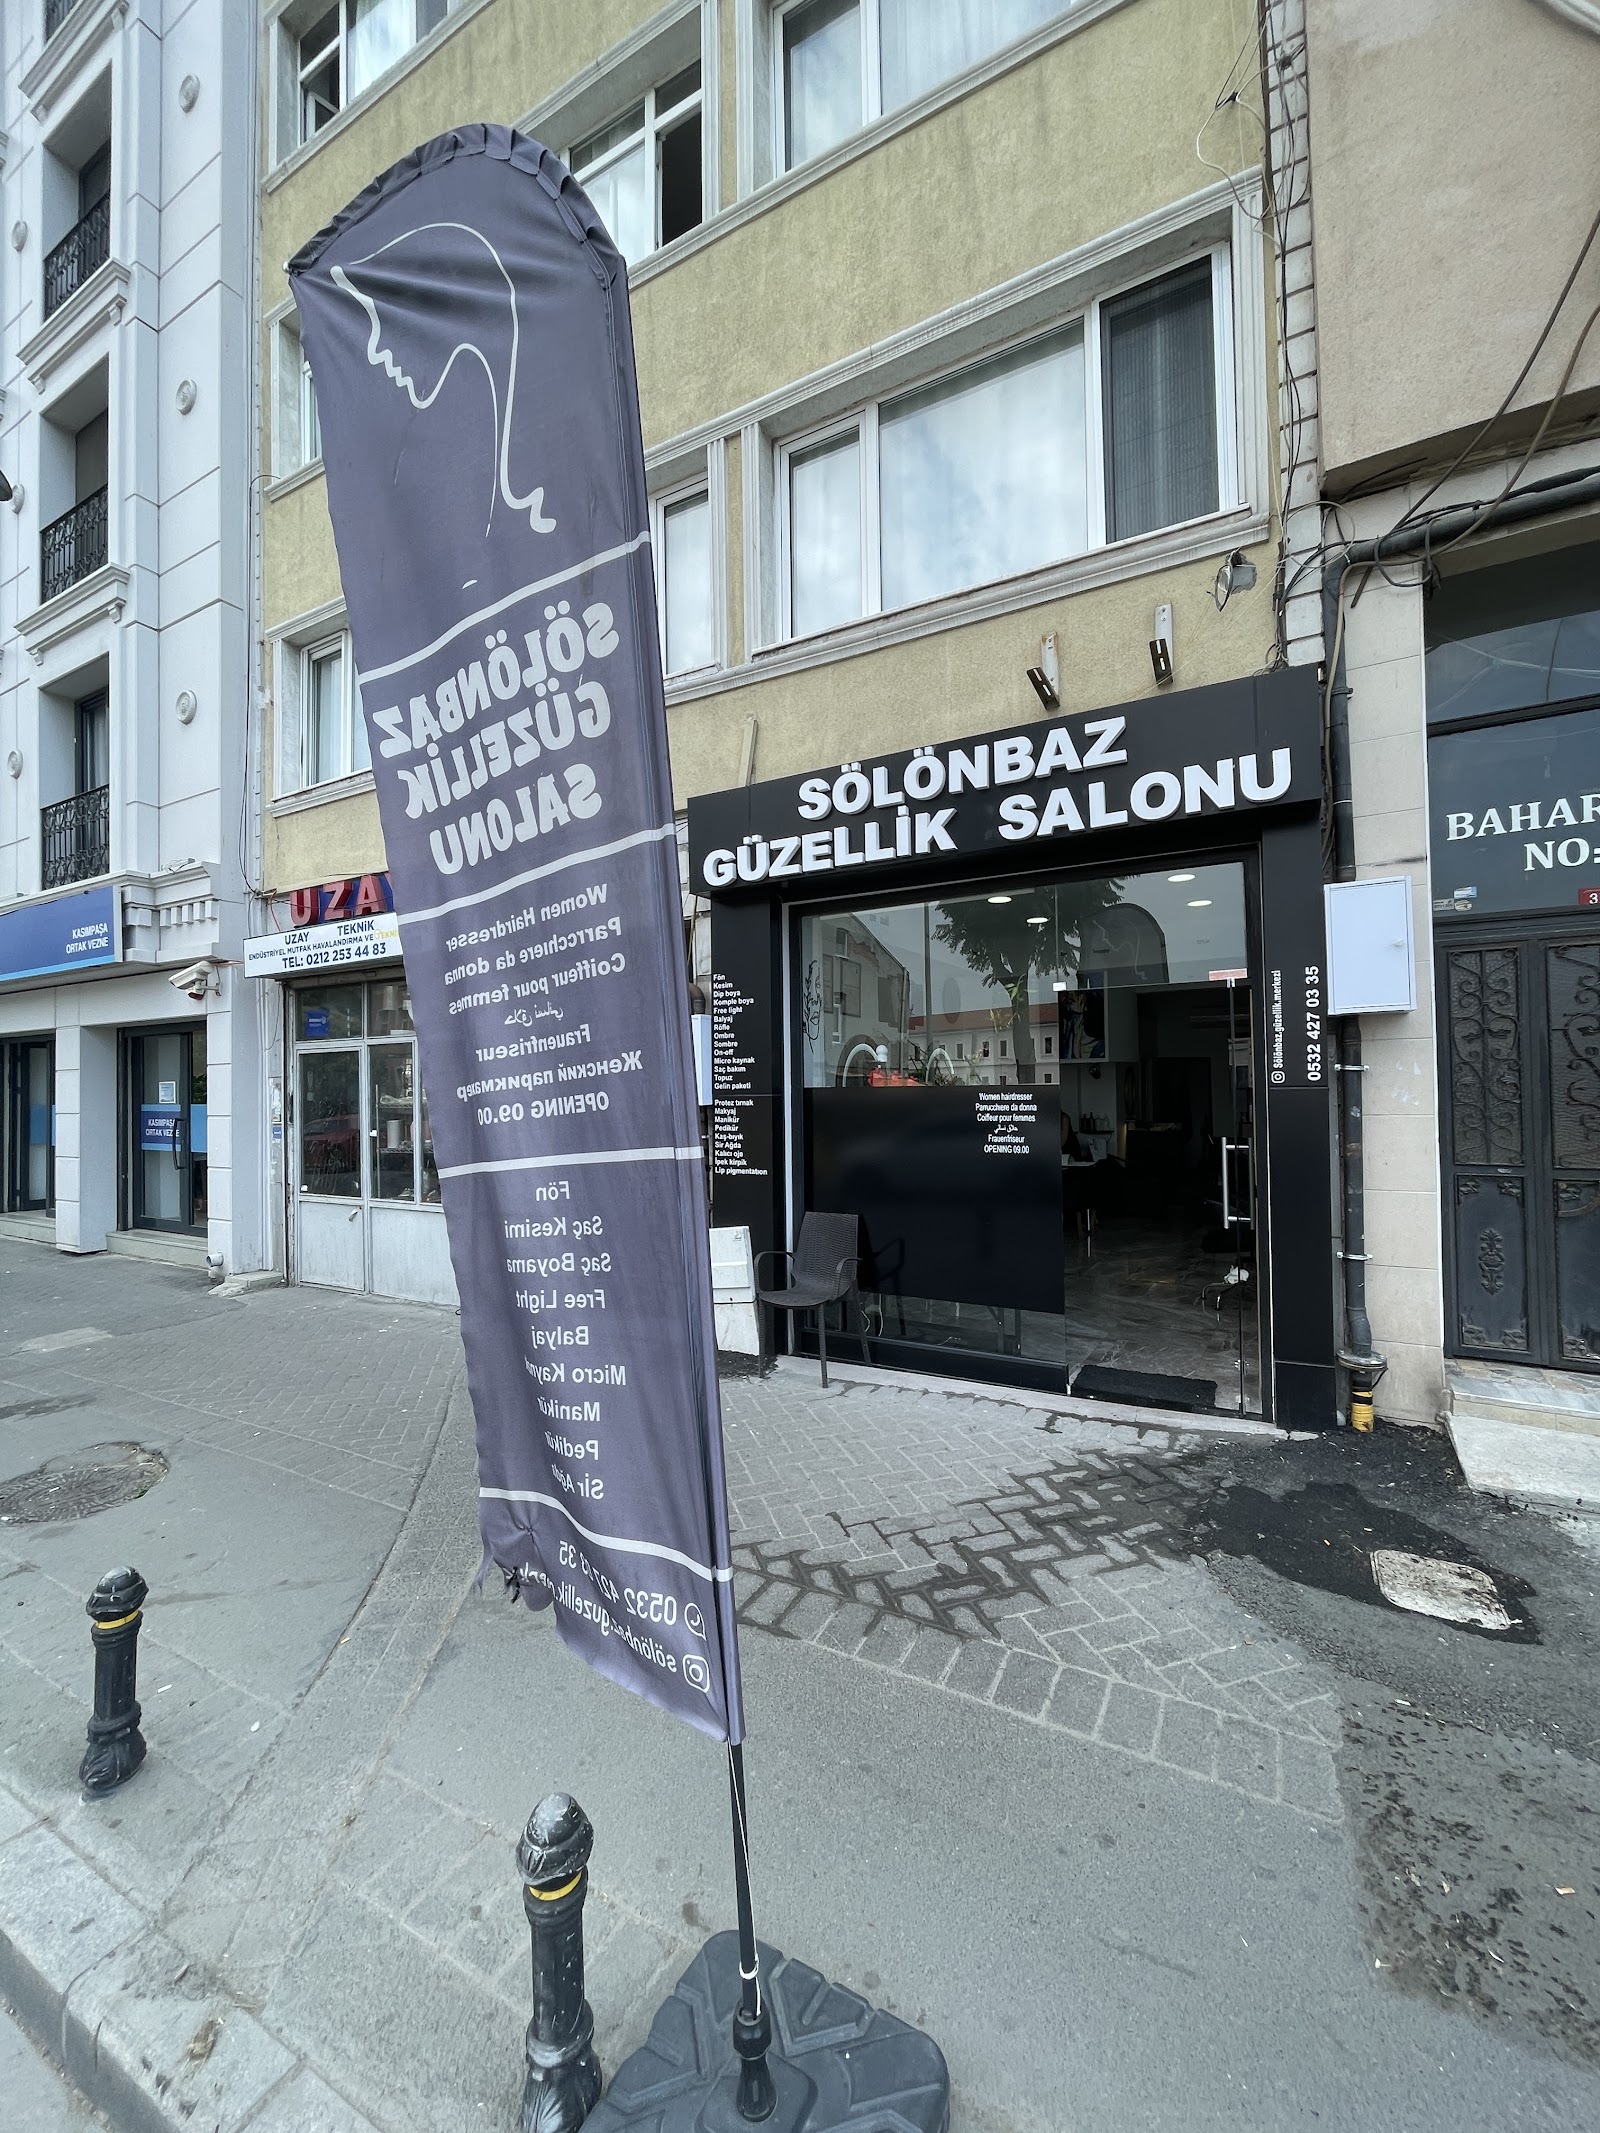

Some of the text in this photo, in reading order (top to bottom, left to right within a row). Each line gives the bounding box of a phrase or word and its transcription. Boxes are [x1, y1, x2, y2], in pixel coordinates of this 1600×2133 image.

[797, 716, 1127, 821] SÖLÖNBAZ
[703, 747, 1292, 888] GÜZELLİK SALONU
[289, 872, 393, 926] UZA
[72, 922, 108, 939] KASIMPAŞA
[285, 920, 375, 945] UZAY TEKNİK
[65, 936, 109, 954] ORTAK VEZNE
[287, 945, 311, 954] MUTFAK
[365, 933, 374, 942] VE
[282, 942, 386, 969] TEL: 0212 253 44 83
[1305, 966, 1321, 1081] 0532 427 03 35
[979, 1092, 1000, 1100] Women
[163, 1129, 180, 1137] VEZE
[984, 1144, 1012, 1153] OPENING
